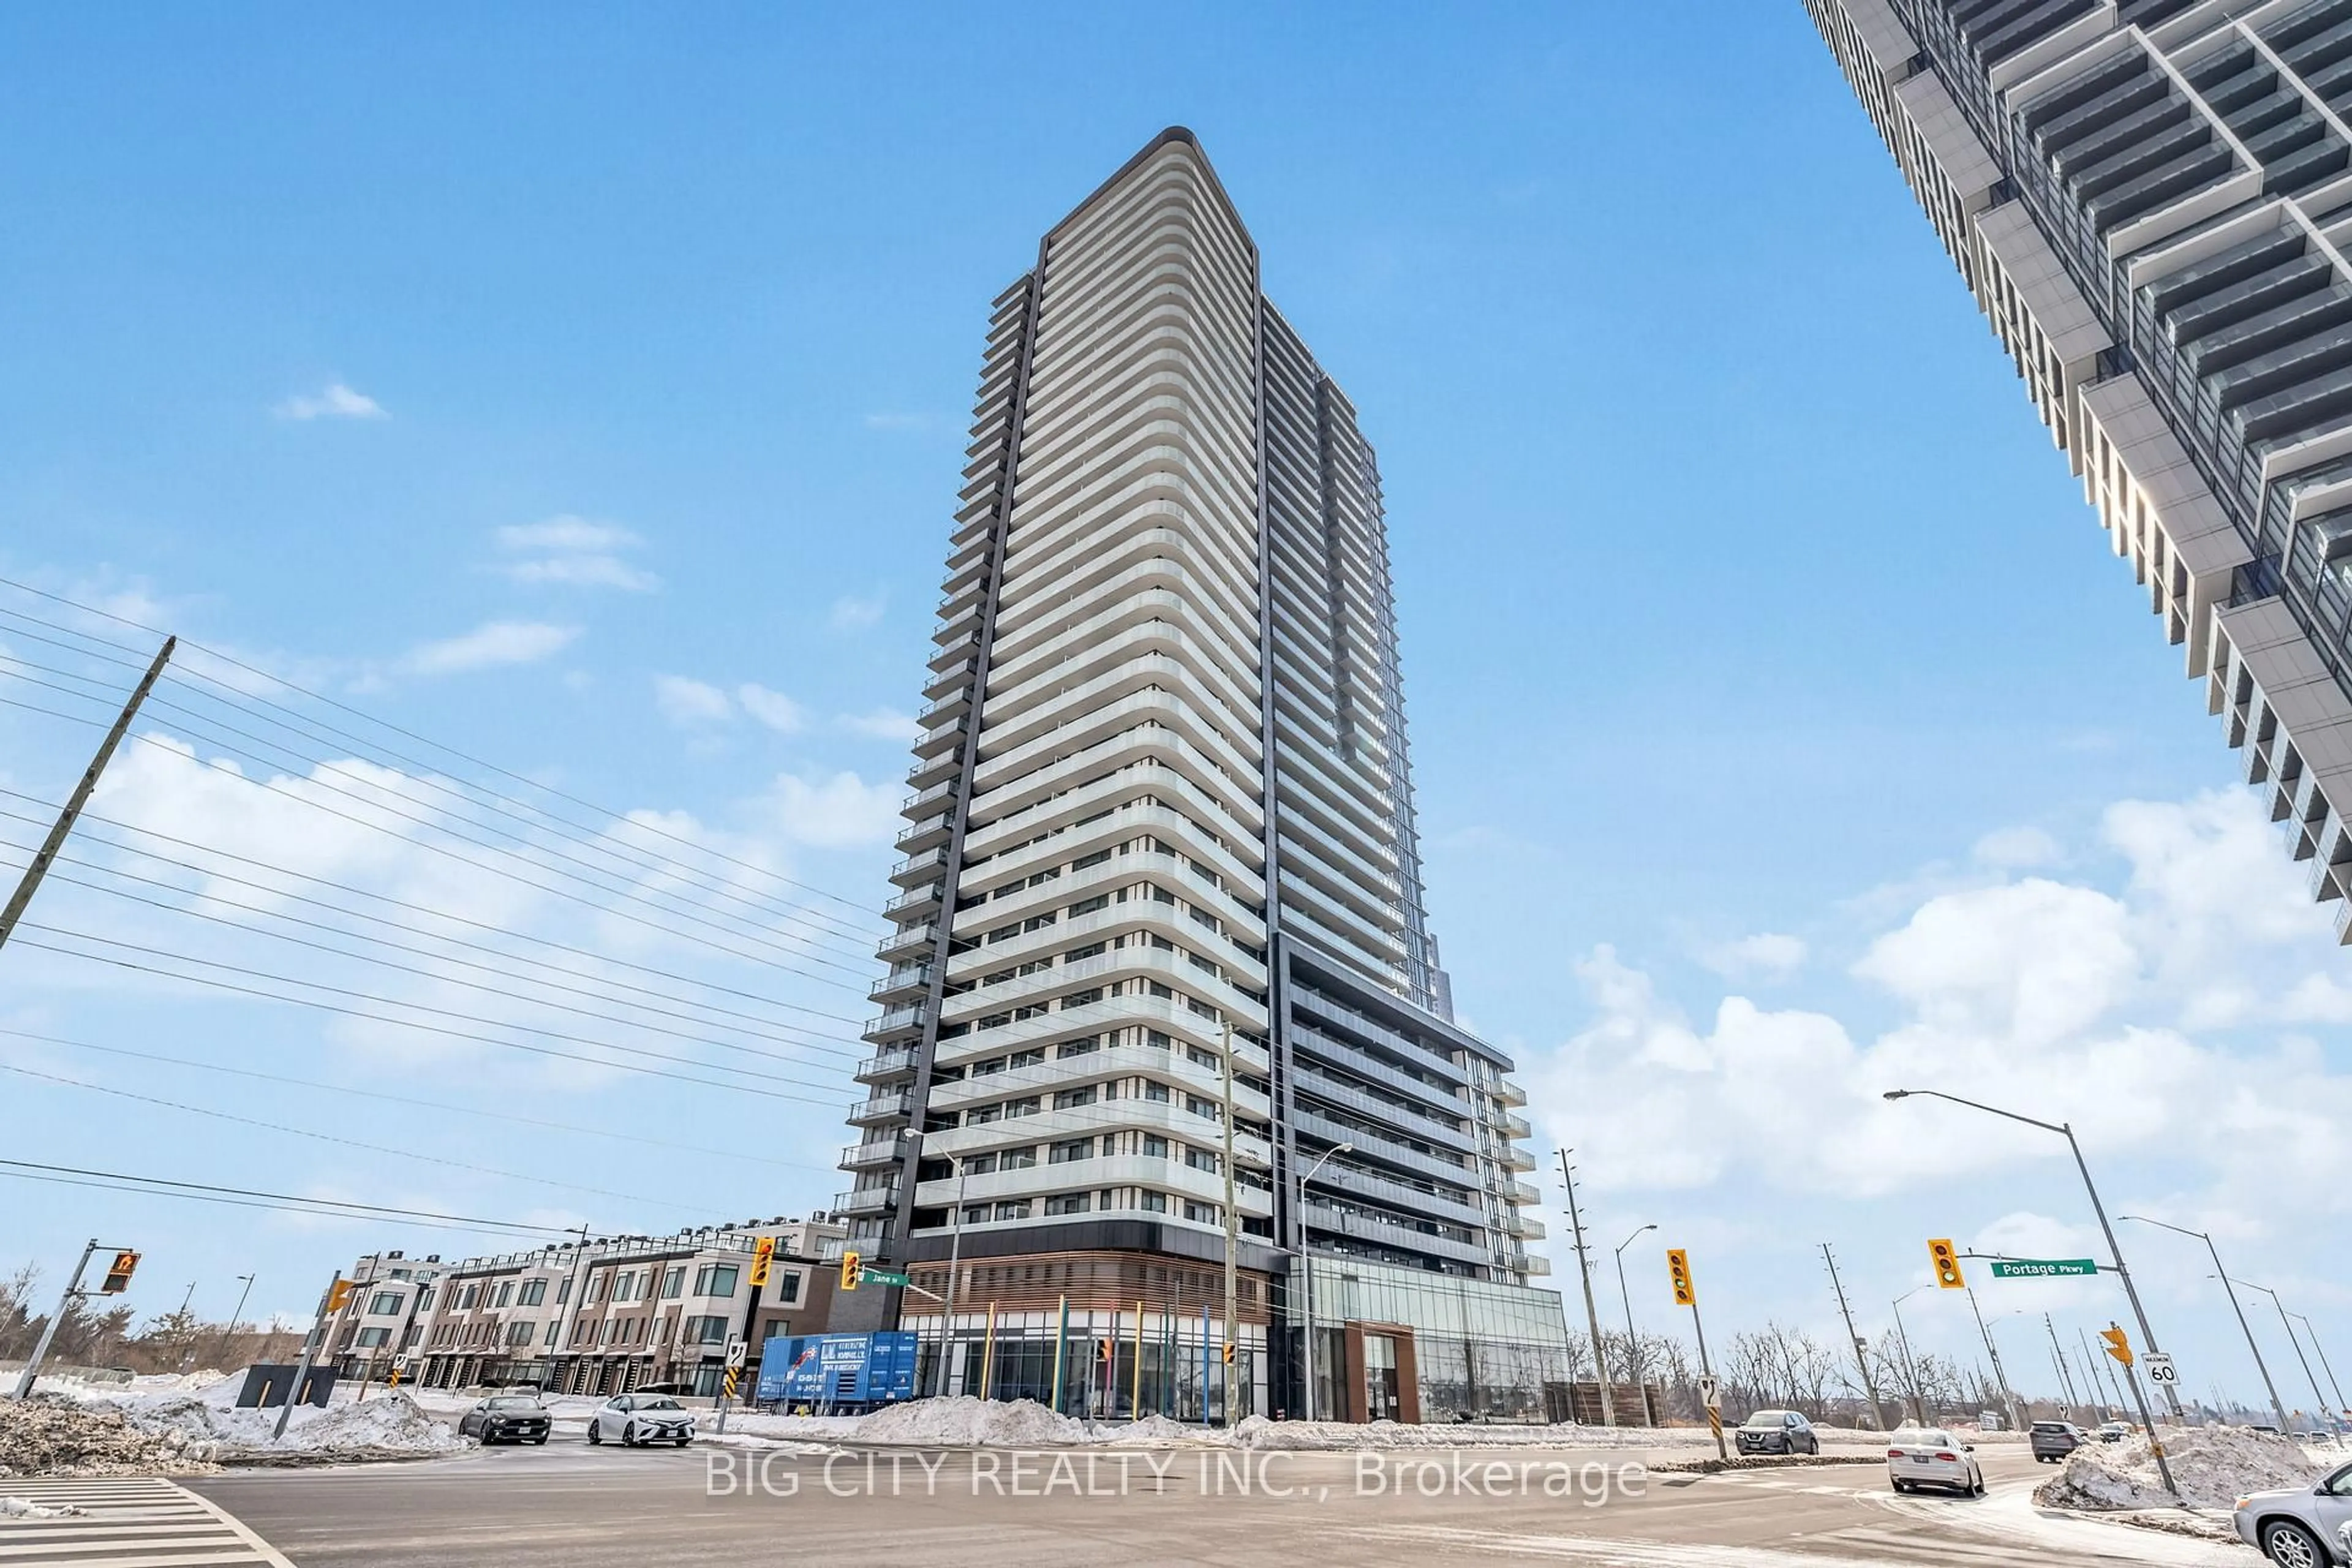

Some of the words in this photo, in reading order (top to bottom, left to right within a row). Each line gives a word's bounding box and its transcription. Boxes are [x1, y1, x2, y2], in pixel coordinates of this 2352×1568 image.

[2003, 1264, 2056, 1276] Portage
[2059, 1265, 2083, 1274] Pkwy
[872, 1274, 891, 1283] Jane
[2152, 1366, 2174, 1381] 60
